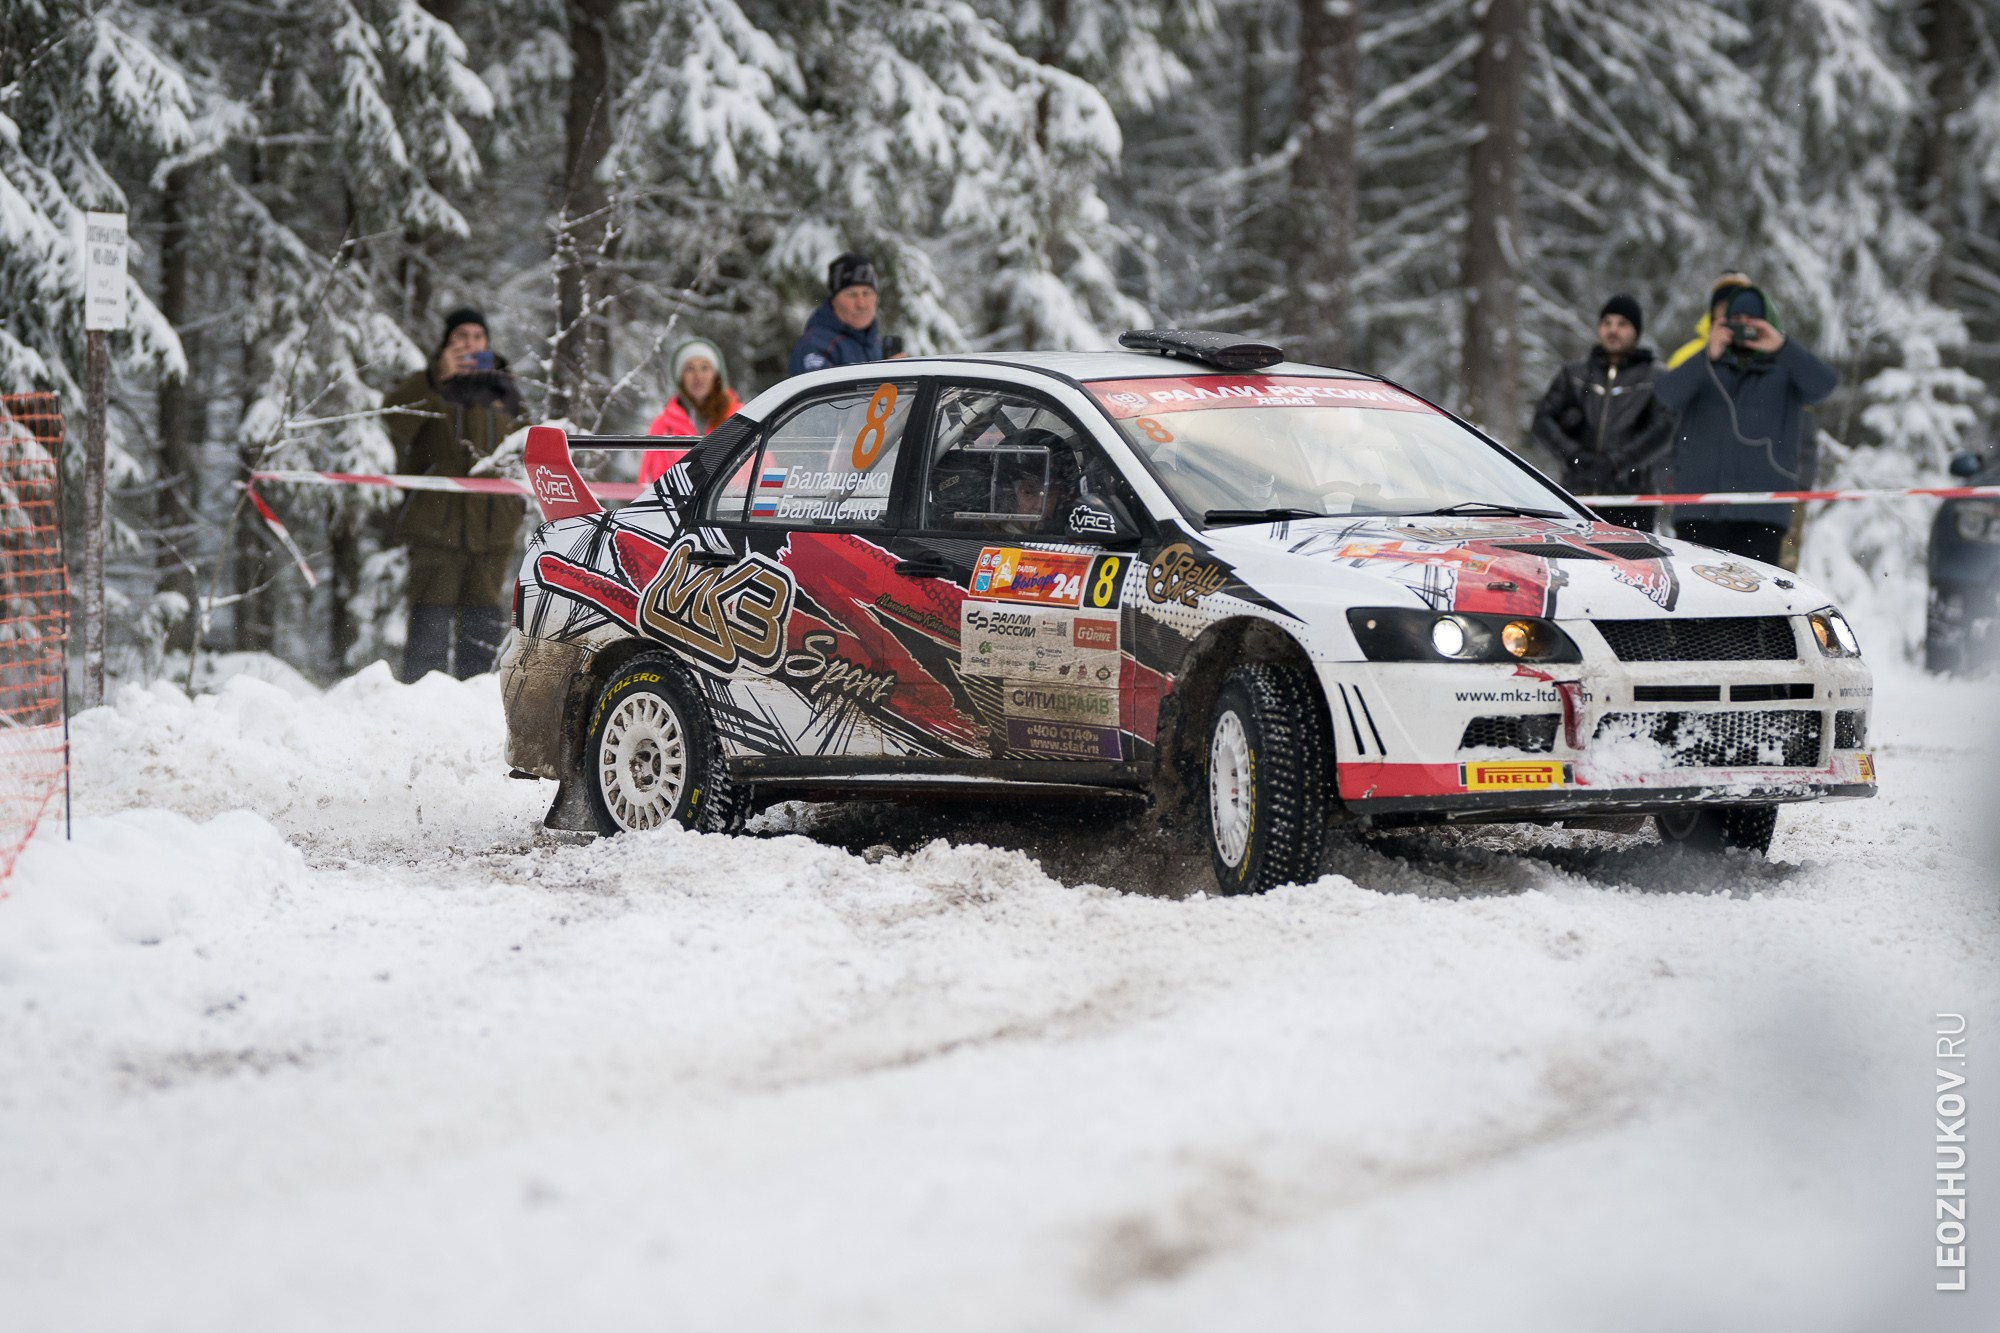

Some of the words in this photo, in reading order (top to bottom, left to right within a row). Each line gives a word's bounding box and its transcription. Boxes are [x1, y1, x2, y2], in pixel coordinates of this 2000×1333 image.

[1149, 386, 1259, 404] РАЛЛИ
[1262, 385, 1389, 402] РОССИИ
[852, 383, 898, 470] 8
[1137, 417, 1174, 443] 8
[786, 466, 888, 495] Балащенко
[777, 494, 880, 524] Балащенко
[1075, 514, 1108, 528] VRC
[1049, 573, 1081, 600] 24
[1093, 556, 1120, 608] 8
[1172, 552, 1228, 597] Rally
[988, 624, 1036, 639] РОССИИ
[990, 612, 1032, 626] РАЛЛИ
[785, 634, 894, 703] Sport
[1012, 689, 1110, 715] СИТИДРАЙВ
[1456, 689, 1593, 702] www.mkz-ltd.m
[1030, 739, 1100, 754] www.staf.ru
[1477, 766, 1553, 784] PIRELLI
